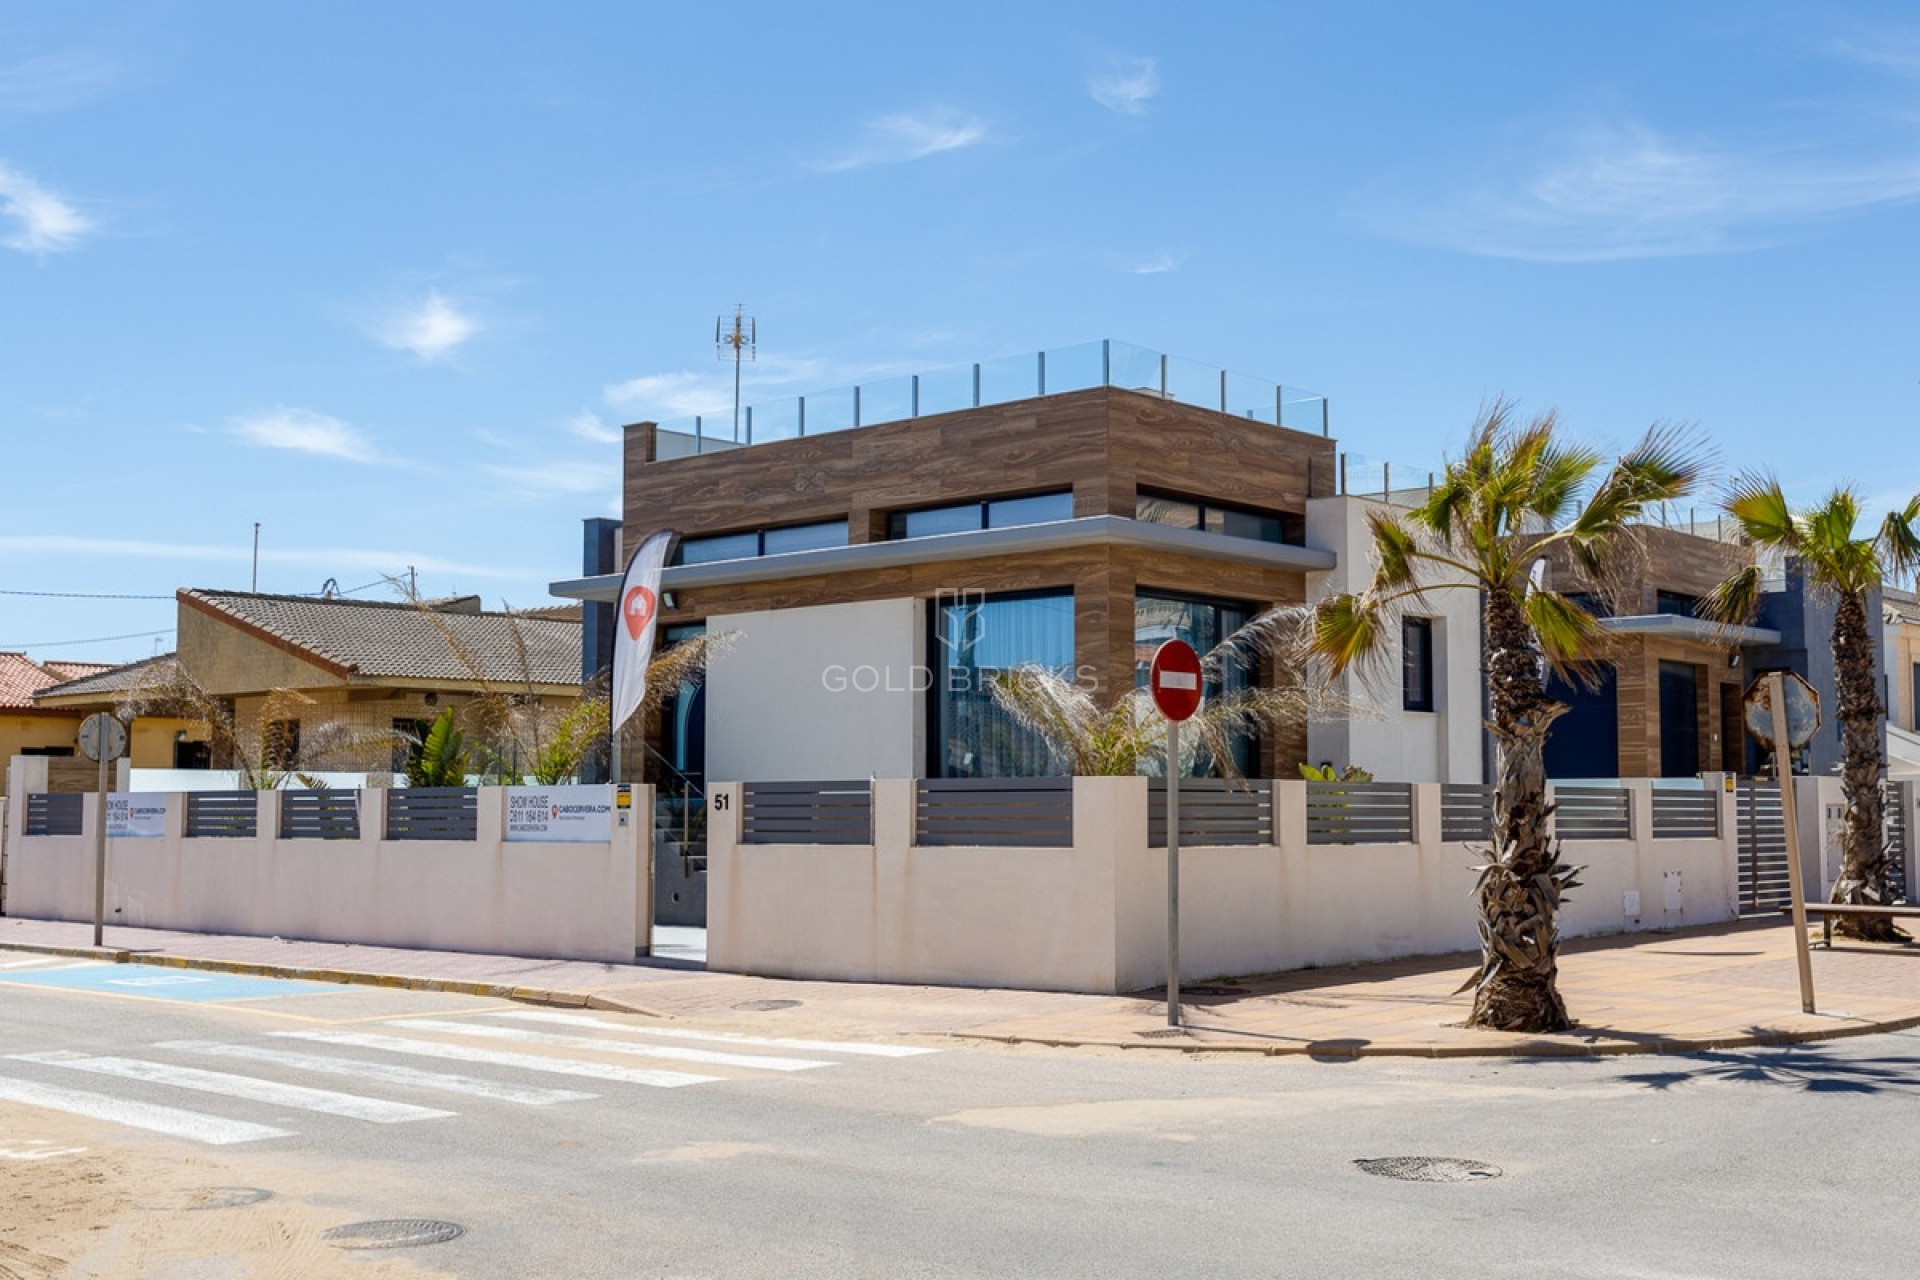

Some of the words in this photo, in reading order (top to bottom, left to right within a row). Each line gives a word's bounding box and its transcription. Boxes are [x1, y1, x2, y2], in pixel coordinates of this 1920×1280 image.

[510, 795, 526, 809] SHOW
[528, 795, 549, 809] HOUSE
[714, 793, 729, 811] 51
